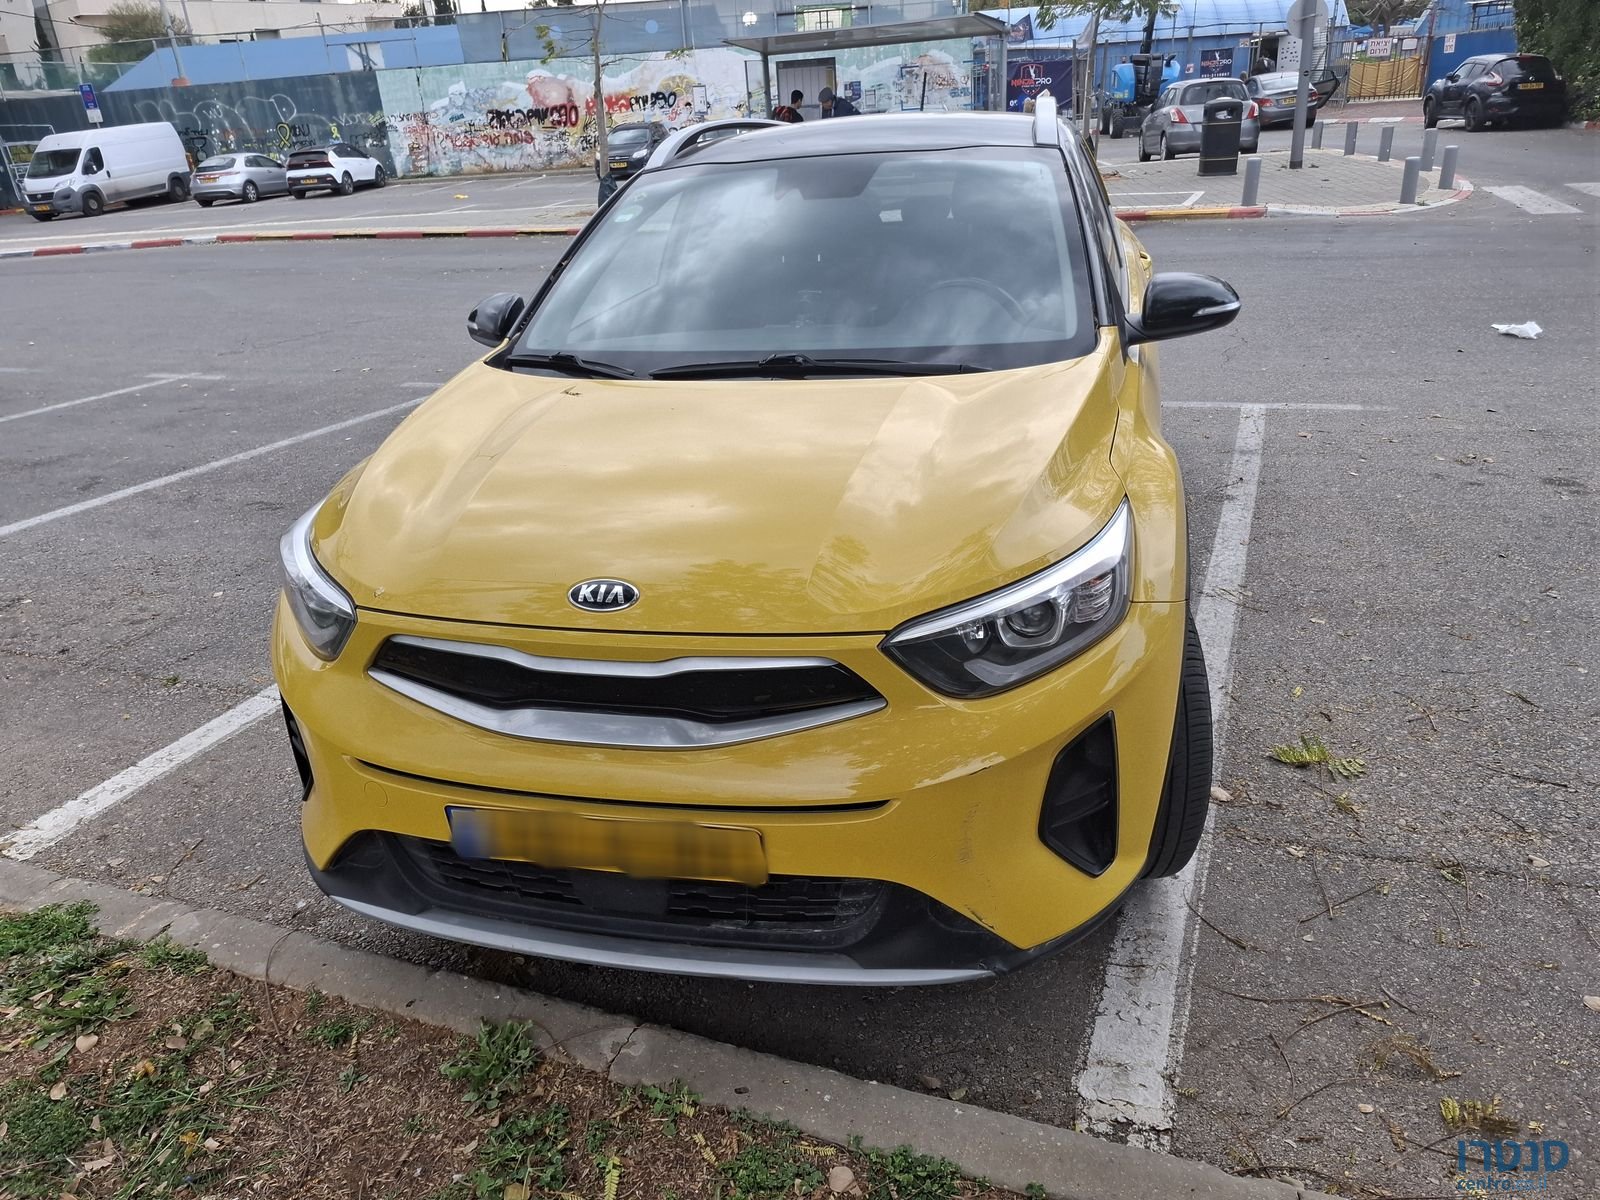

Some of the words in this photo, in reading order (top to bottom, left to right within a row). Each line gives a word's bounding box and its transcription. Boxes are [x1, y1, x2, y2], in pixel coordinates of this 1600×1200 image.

[1370, 39, 1391, 47] יציאת
[1011, 78, 1035, 88] NINJA
[1034, 77, 1052, 85] PRO
[578, 584, 625, 604] KIA
